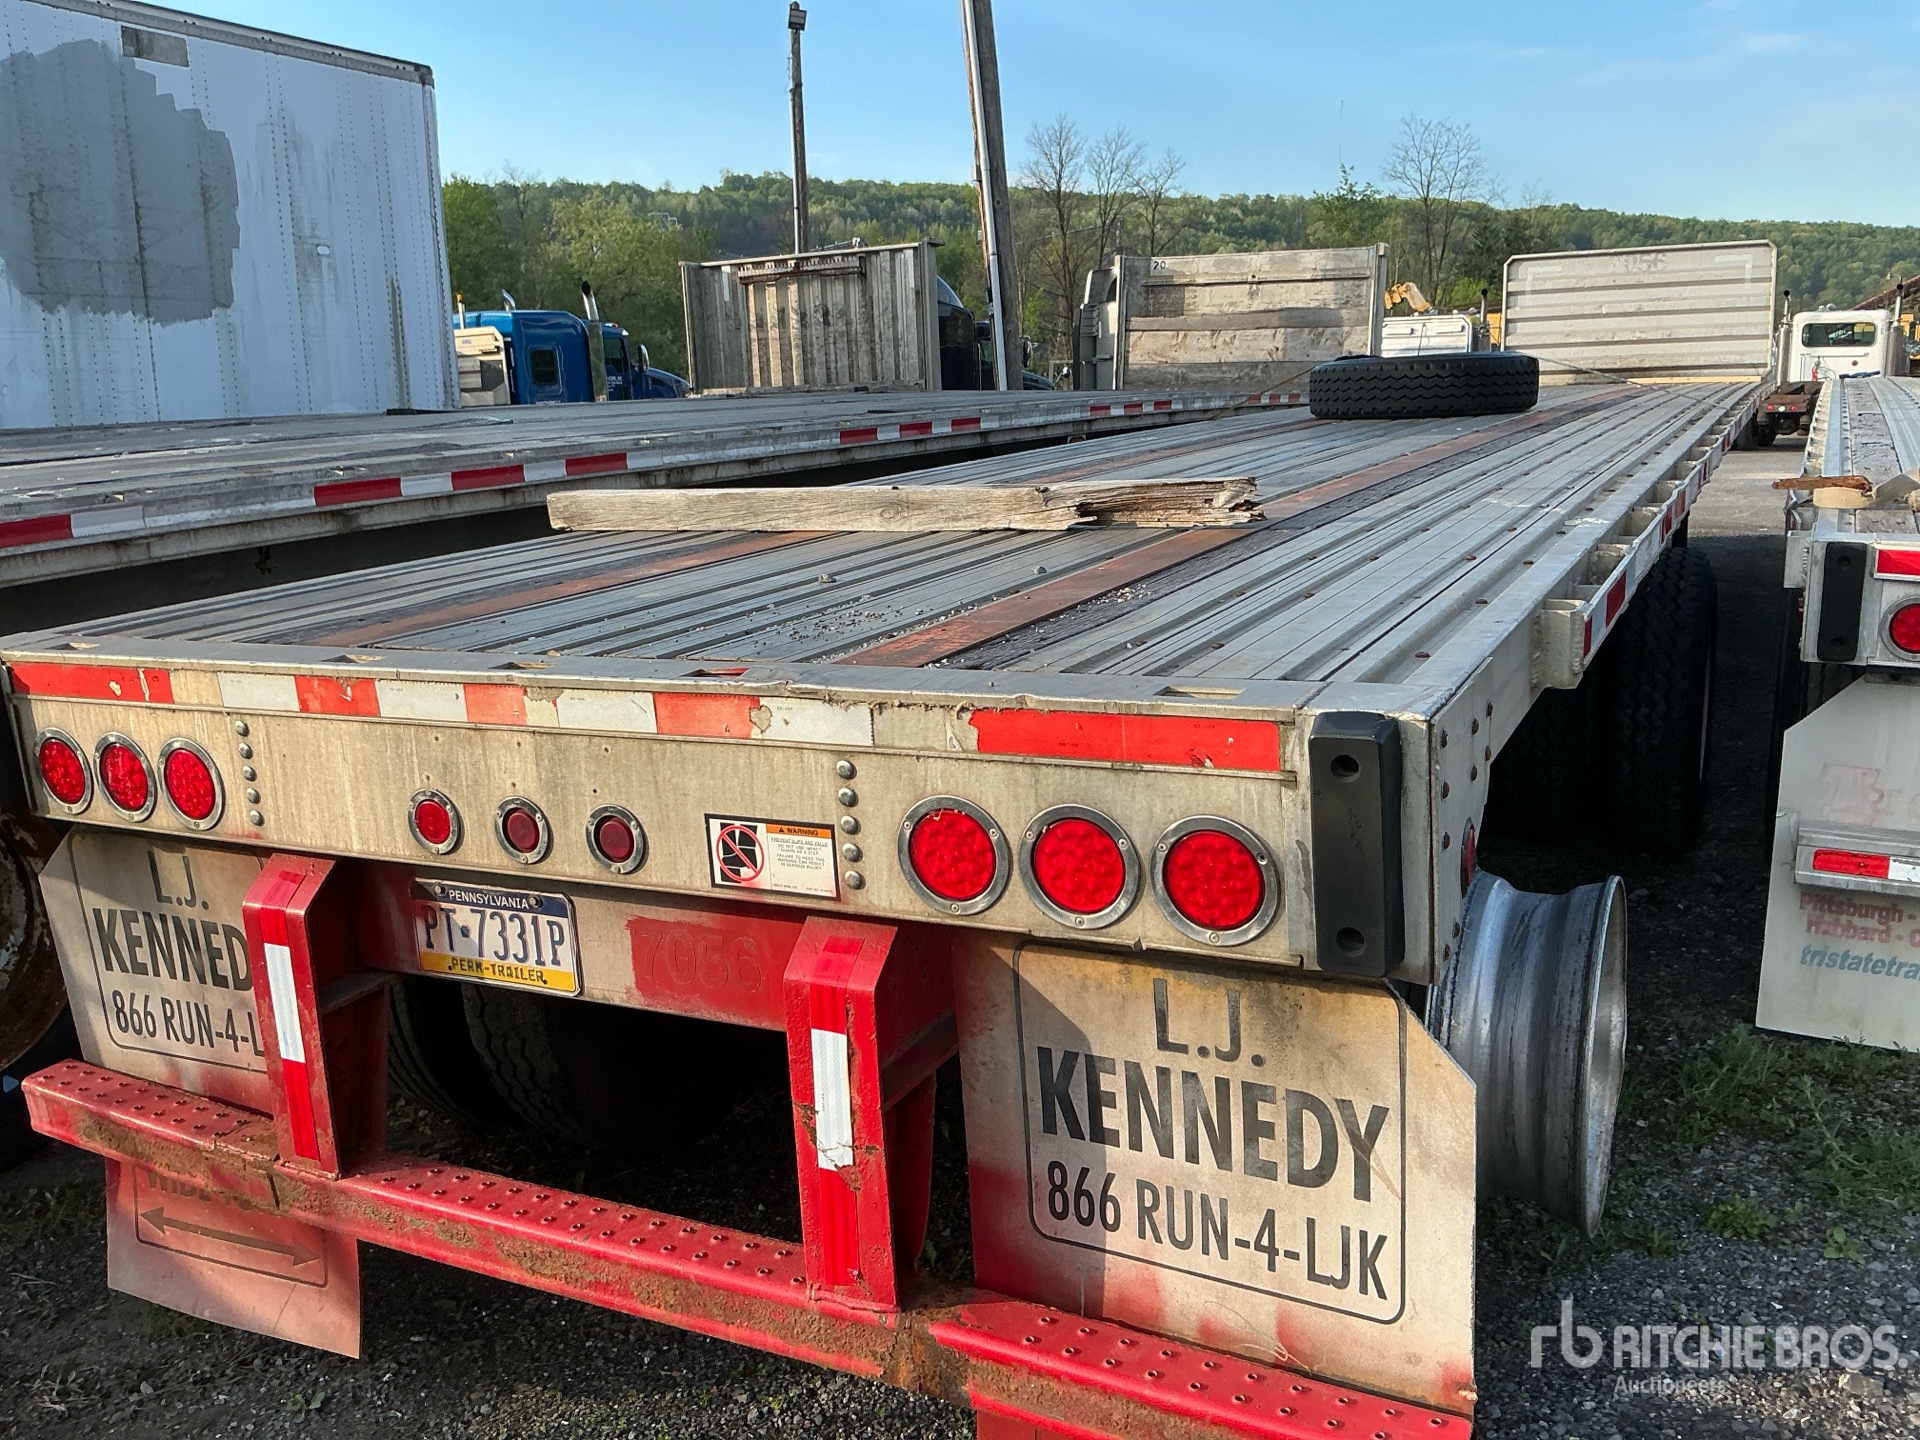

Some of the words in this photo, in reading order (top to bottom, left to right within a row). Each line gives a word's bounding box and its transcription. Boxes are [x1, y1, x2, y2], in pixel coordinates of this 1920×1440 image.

[787, 827, 818, 836] WARNING
[147, 850, 210, 910] L.J.
[448, 889, 530, 910] PENNSYLVANIA
[92, 908, 253, 991] KENNED
[450, 957, 545, 983] PERM-TRAILER
[1800, 944, 1920, 980] tristatetra
[112, 989, 157, 1038] 866
[160, 996, 265, 1057] RUN-4-L
[1153, 977, 1265, 1068] L.J.
[1037, 1046, 1390, 1203] KENNEDY
[1047, 1160, 1122, 1233] 866
[1136, 1178, 1389, 1301] RUN-4-LJK
